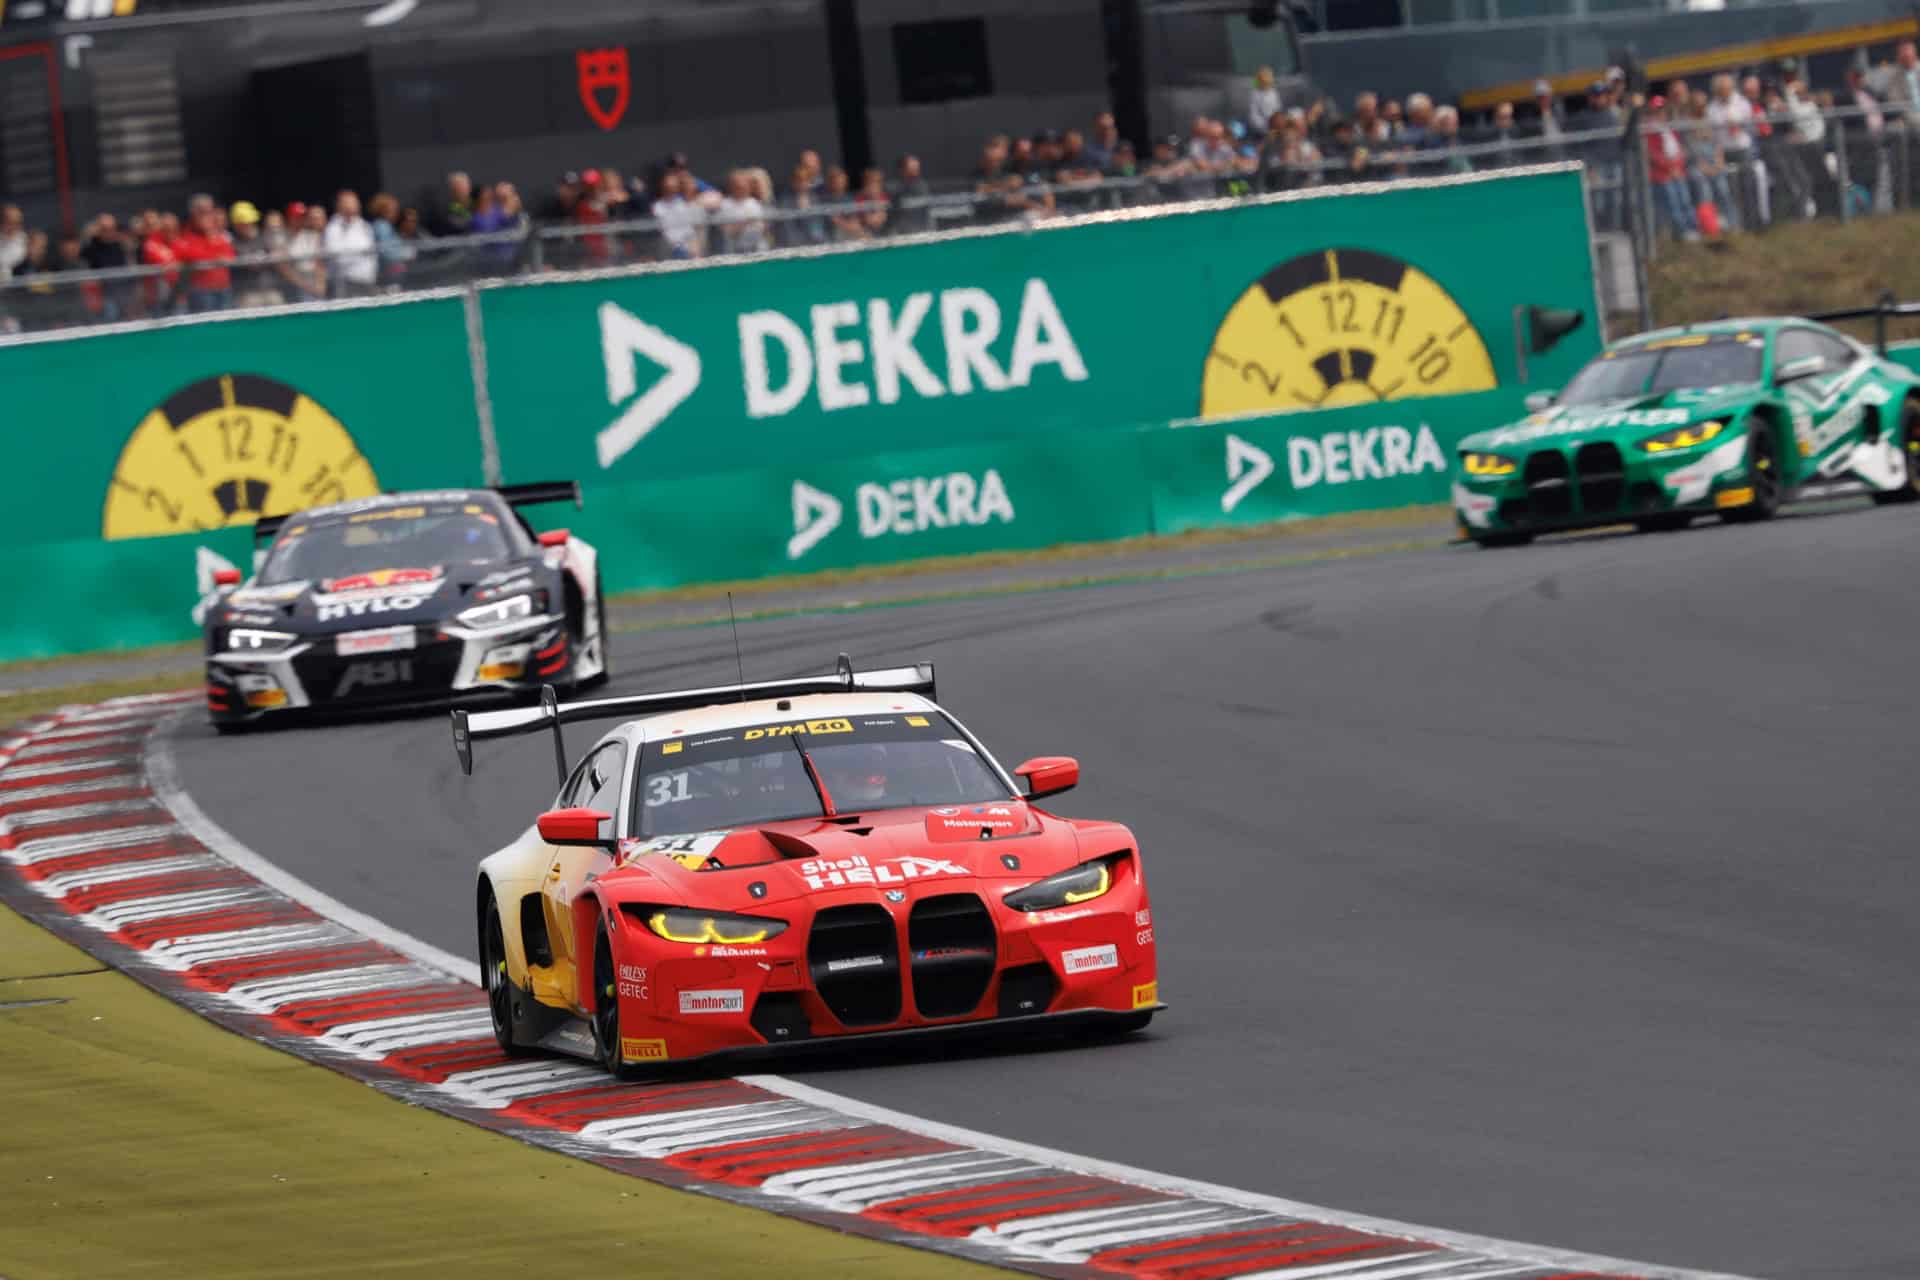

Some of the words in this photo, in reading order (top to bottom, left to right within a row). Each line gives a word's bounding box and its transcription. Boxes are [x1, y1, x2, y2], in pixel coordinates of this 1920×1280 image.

[738, 278, 1089, 418] DEKRA
[1241, 361, 1283, 396] 2
[1278, 313, 1305, 348] 1
[1320, 290, 1361, 333] 12
[1372, 299, 1405, 346] 11
[1408, 334, 1452, 384] 10
[143, 487, 183, 523] 2
[176, 441, 205, 477] 1
[218, 416, 255, 461] 12
[268, 424, 299, 476] 11
[1287, 421, 1447, 489] DEKRA
[856, 468, 1015, 538] DEKRA
[744, 724, 807, 740] DTM
[814, 721, 846, 731] 40
[645, 772, 693, 807] 31
[944, 818, 1013, 828] Motorsport
[801, 855, 869, 875] Shell
[803, 856, 971, 890] HELIX
[619, 981, 648, 999] GETEC
